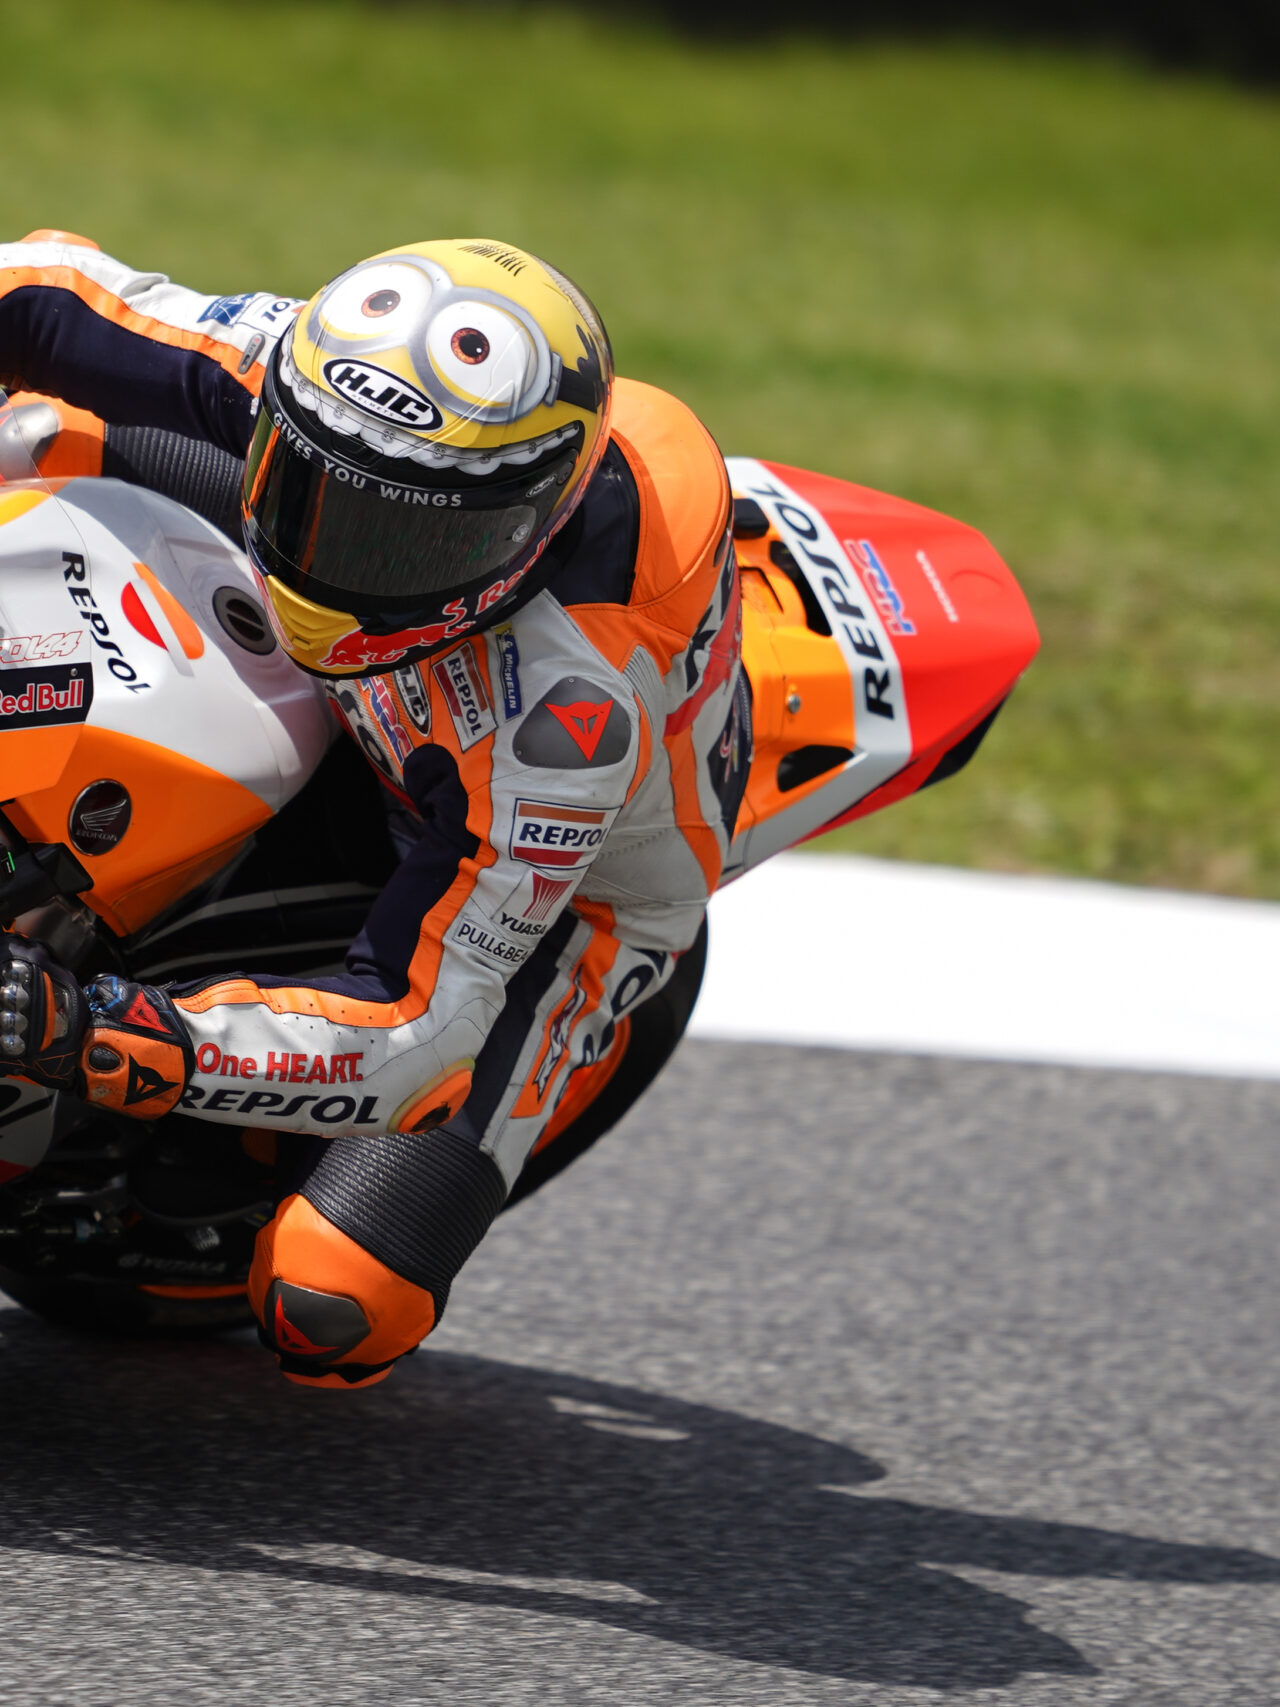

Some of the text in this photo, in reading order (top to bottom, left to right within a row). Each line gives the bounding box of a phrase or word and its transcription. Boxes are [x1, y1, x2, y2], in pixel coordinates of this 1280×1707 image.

[333, 366, 431, 422] HJC
[273, 412, 462, 507] GIVES YOU WINGS
[62, 551, 152, 694] REPSOL
[747, 482, 896, 721] REPSOL
[448, 657, 483, 736] REPSOL
[500, 911, 548, 936] YUASA
[196, 1042, 364, 1085] One HEART.
